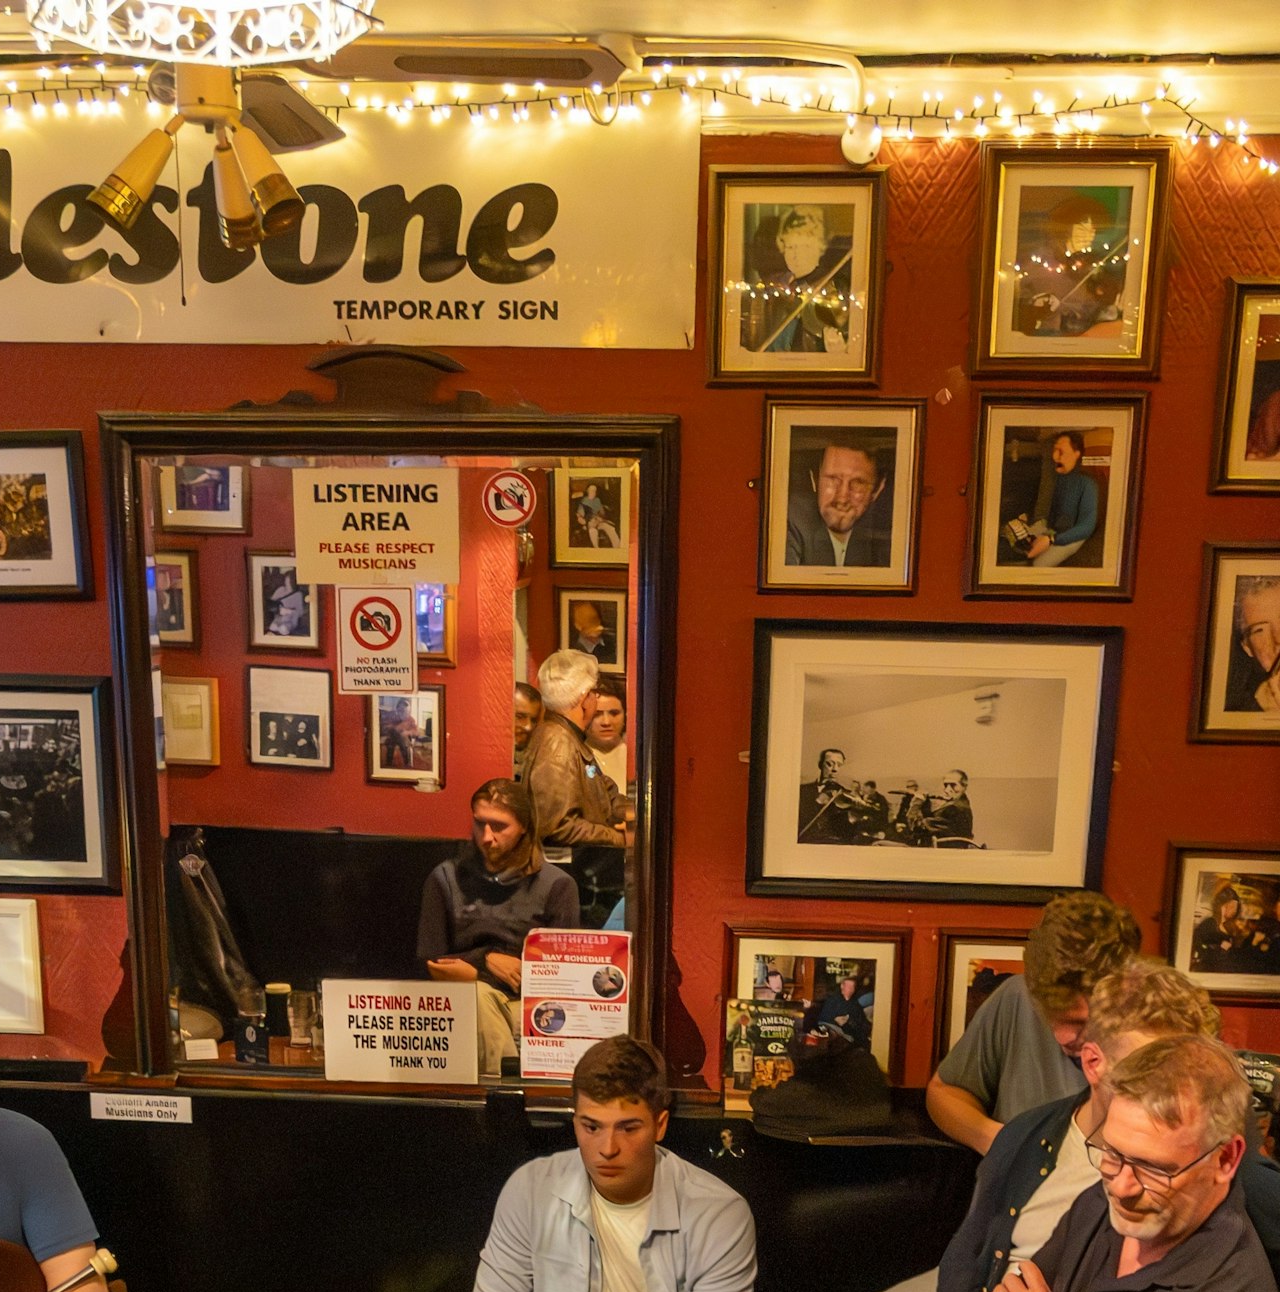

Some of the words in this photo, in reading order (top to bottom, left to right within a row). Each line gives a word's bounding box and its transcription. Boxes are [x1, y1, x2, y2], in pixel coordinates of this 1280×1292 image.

[333, 299, 486, 320] TEMPORARY
[497, 300, 559, 320] SIGN
[313, 483, 438, 504] LISTENING
[341, 511, 410, 531] AREA
[319, 543, 370, 555] PLEASE
[376, 543, 435, 555] RESPECT
[338, 558, 417, 570] MUSICIANS
[356, 657, 370, 665] NO
[372, 657, 397, 665] FLASH
[353, 678, 382, 687] THANK
[383, 678, 402, 687] YOU
[564, 954, 612, 965] SCHEDULE
[530, 968, 560, 976] KNOW
[348, 994, 412, 1011] LISTENING
[417, 995, 452, 1012] AREA
[589, 1003, 622, 1013] WHEN
[347, 1014, 397, 1031] PLEASE
[399, 1015, 455, 1032] RESPECT
[756, 1015, 796, 1028] JAMESON
[353, 1034, 377, 1050] THE
[382, 1035, 449, 1051] MUSICIANS
[527, 1038, 566, 1048] WHERE
[389, 1055, 424, 1068] THANK
[426, 1056, 448, 1069] YOU
[105, 1107, 154, 1119] Musicians
[156, 1109, 178, 1120] Only
